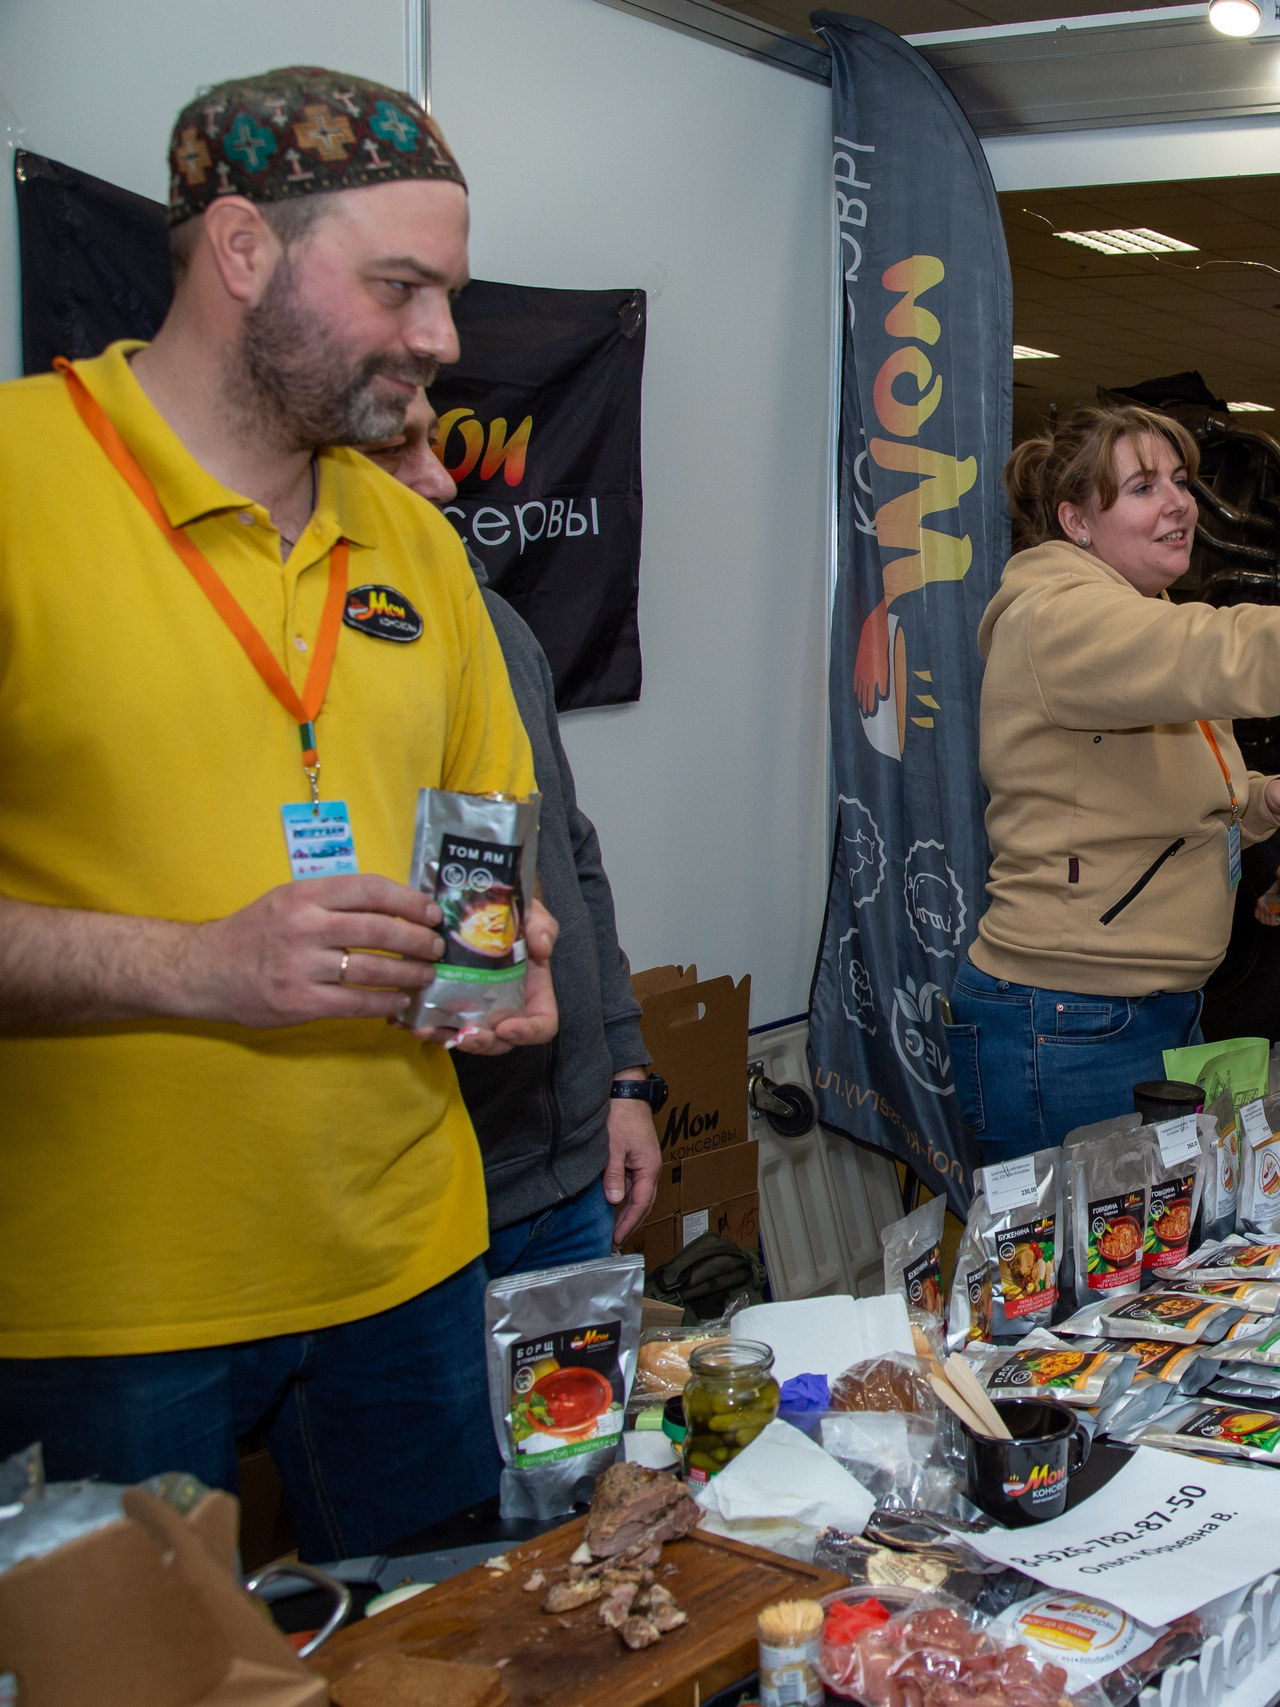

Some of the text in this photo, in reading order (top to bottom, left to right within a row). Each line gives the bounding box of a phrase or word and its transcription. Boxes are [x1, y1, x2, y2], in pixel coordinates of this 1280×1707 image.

[431, 407, 533, 487] ои
[443, 497, 600, 555] сервы
[448, 844, 505, 866] ТОМ ЯМ
[661, 1102, 720, 1149] Мои
[670, 1127, 738, 1162] консервы
[1021, 1186, 1038, 1197] 230,00
[997, 1227, 1030, 1242] БУЖЕНИНА
[517, 1341, 554, 1359] БОРЩ
[1027, 1463, 1066, 1490] Мои
[1010, 1485, 1207, 1568] 8-926-782-87-50
[1078, 1511, 1239, 1575] Ольга Юрьевна В.
[1066, 1611, 1118, 1633] консервы
